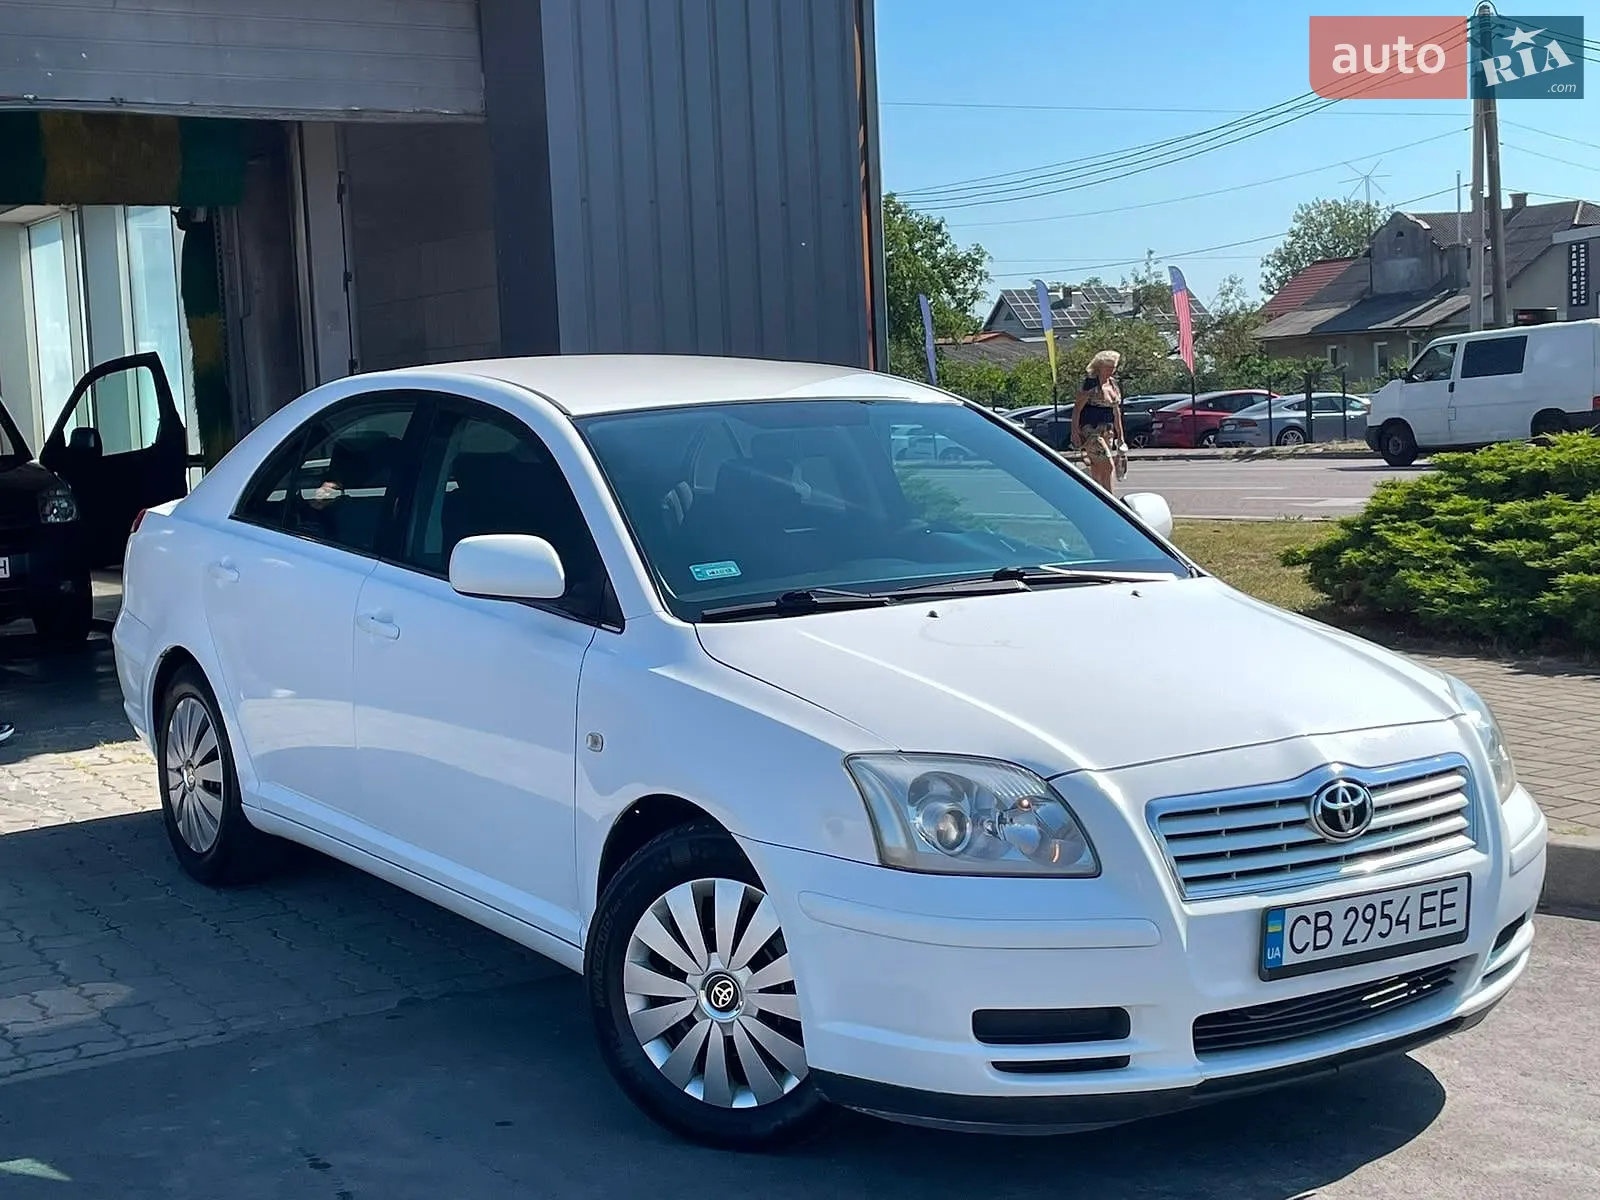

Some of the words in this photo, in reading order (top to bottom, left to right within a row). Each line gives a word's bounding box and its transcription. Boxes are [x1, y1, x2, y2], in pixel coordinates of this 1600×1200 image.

[1289, 910, 1333, 954] CB
[1342, 895, 1411, 947] 2954
[1419, 886, 1458, 931] EE
[1267, 947, 1281, 960] UA
